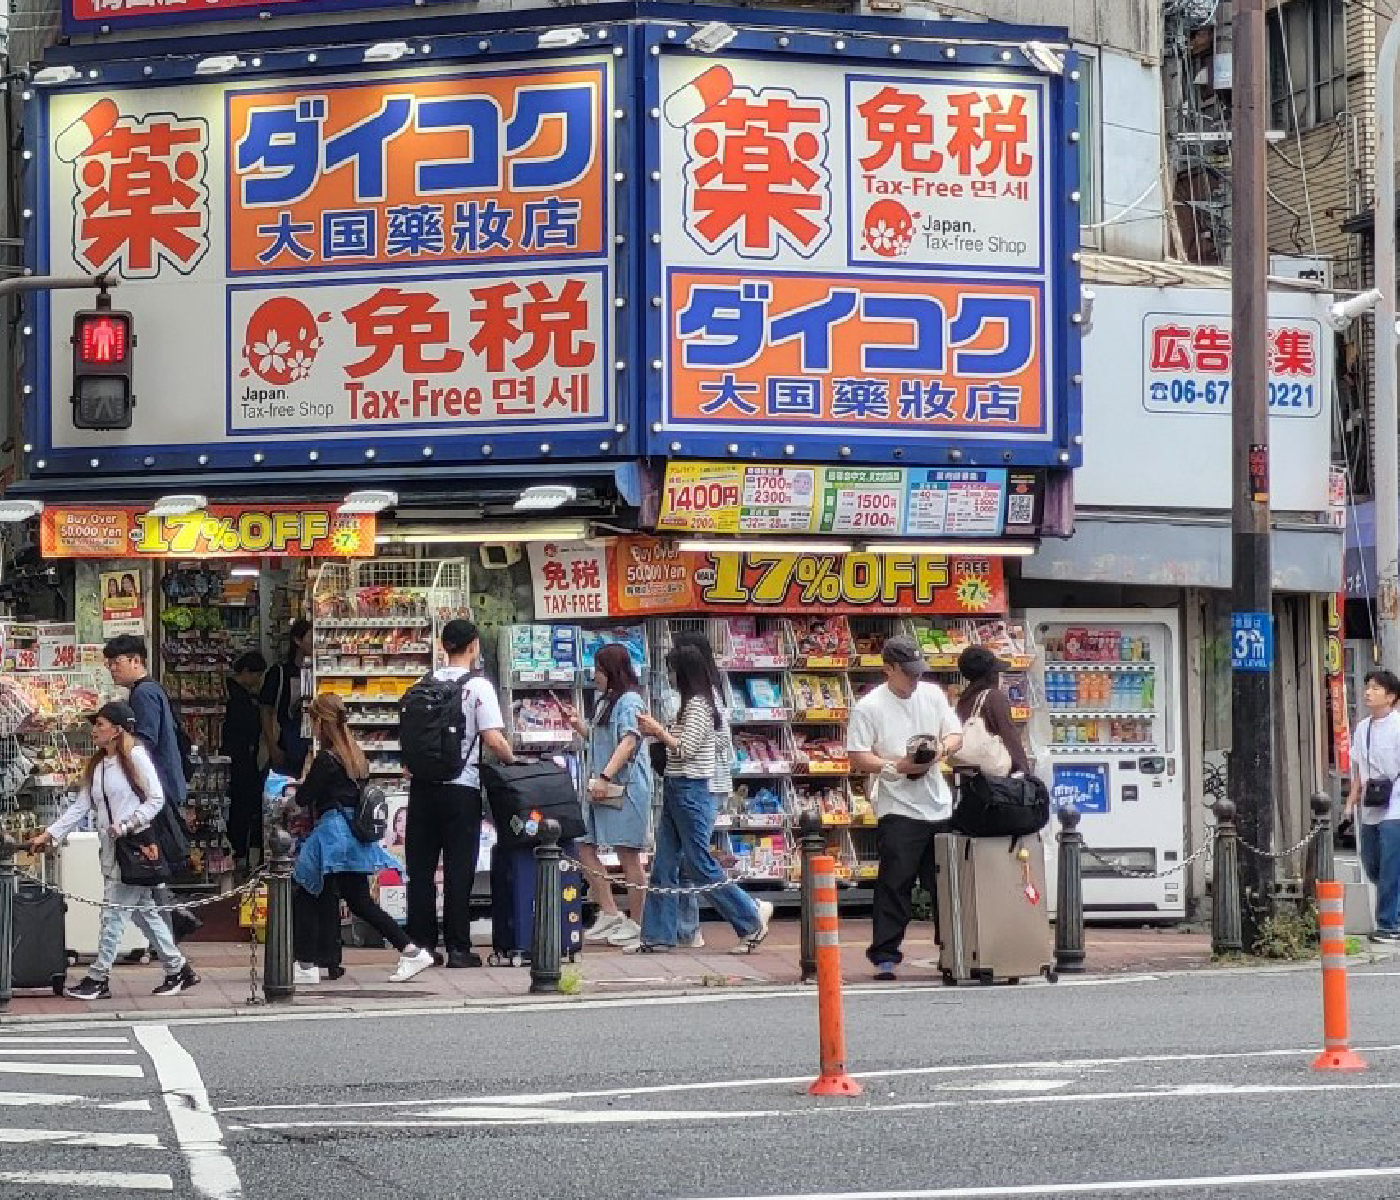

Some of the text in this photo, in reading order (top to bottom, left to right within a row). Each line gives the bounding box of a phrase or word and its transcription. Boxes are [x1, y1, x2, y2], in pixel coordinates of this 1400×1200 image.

[238, 87, 595, 206] ダイコク
[857, 86, 1033, 177] 免税
[692, 96, 824, 250] 薬
[862, 174, 963, 198] Tax-Free
[80, 118, 202, 270] 薬
[970, 179, 1029, 200] 면세
[923, 215, 976, 234] Japan.
[923, 234, 1026, 255] Tax-free Shop
[342, 279, 596, 378] 免税
[676, 281, 1035, 377] ダイコク
[1150, 324, 1316, 376] 広告集
[241, 386, 289, 402] Japan.
[344, 379, 481, 420] Tax-Free
[491, 373, 589, 416] 면세
[241, 402, 334, 419] Tax-free Shop
[668, 482, 738, 512] 1400円
[67, 513, 117, 524] Buy Over
[102, 527, 122, 537] Yen
[542, 559, 600, 590] 免税
[663, 564, 687, 579] Yen
[703, 551, 950, 604] 17%OFF
[543, 594, 603, 614] TAX-FREE
